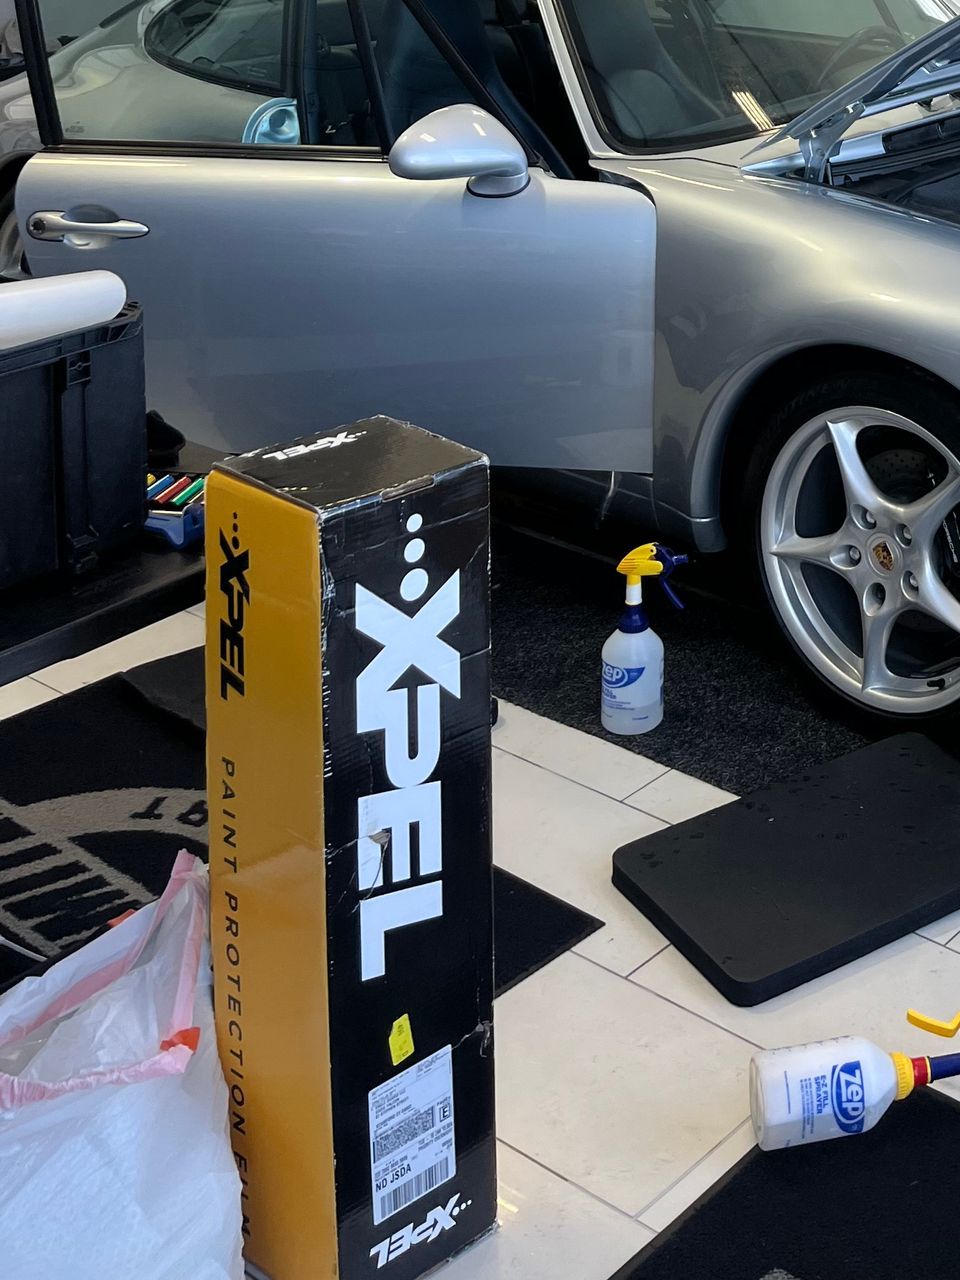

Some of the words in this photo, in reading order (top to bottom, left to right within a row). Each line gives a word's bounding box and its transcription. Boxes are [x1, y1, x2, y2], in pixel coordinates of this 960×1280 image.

[262, 431, 357, 461] XPEL
[219, 527, 250, 701] XPEL
[221, 756, 237, 874] PAINT
[355, 568, 461, 982] XPEL
[224, 891, 246, 1136] PROTECTION
[814, 1077, 823, 1114] SPRAYER
[375, 1177, 388, 1193] ND
[390, 1163, 412, 1184] JSDA
[369, 1192, 461, 1270] XPEL
